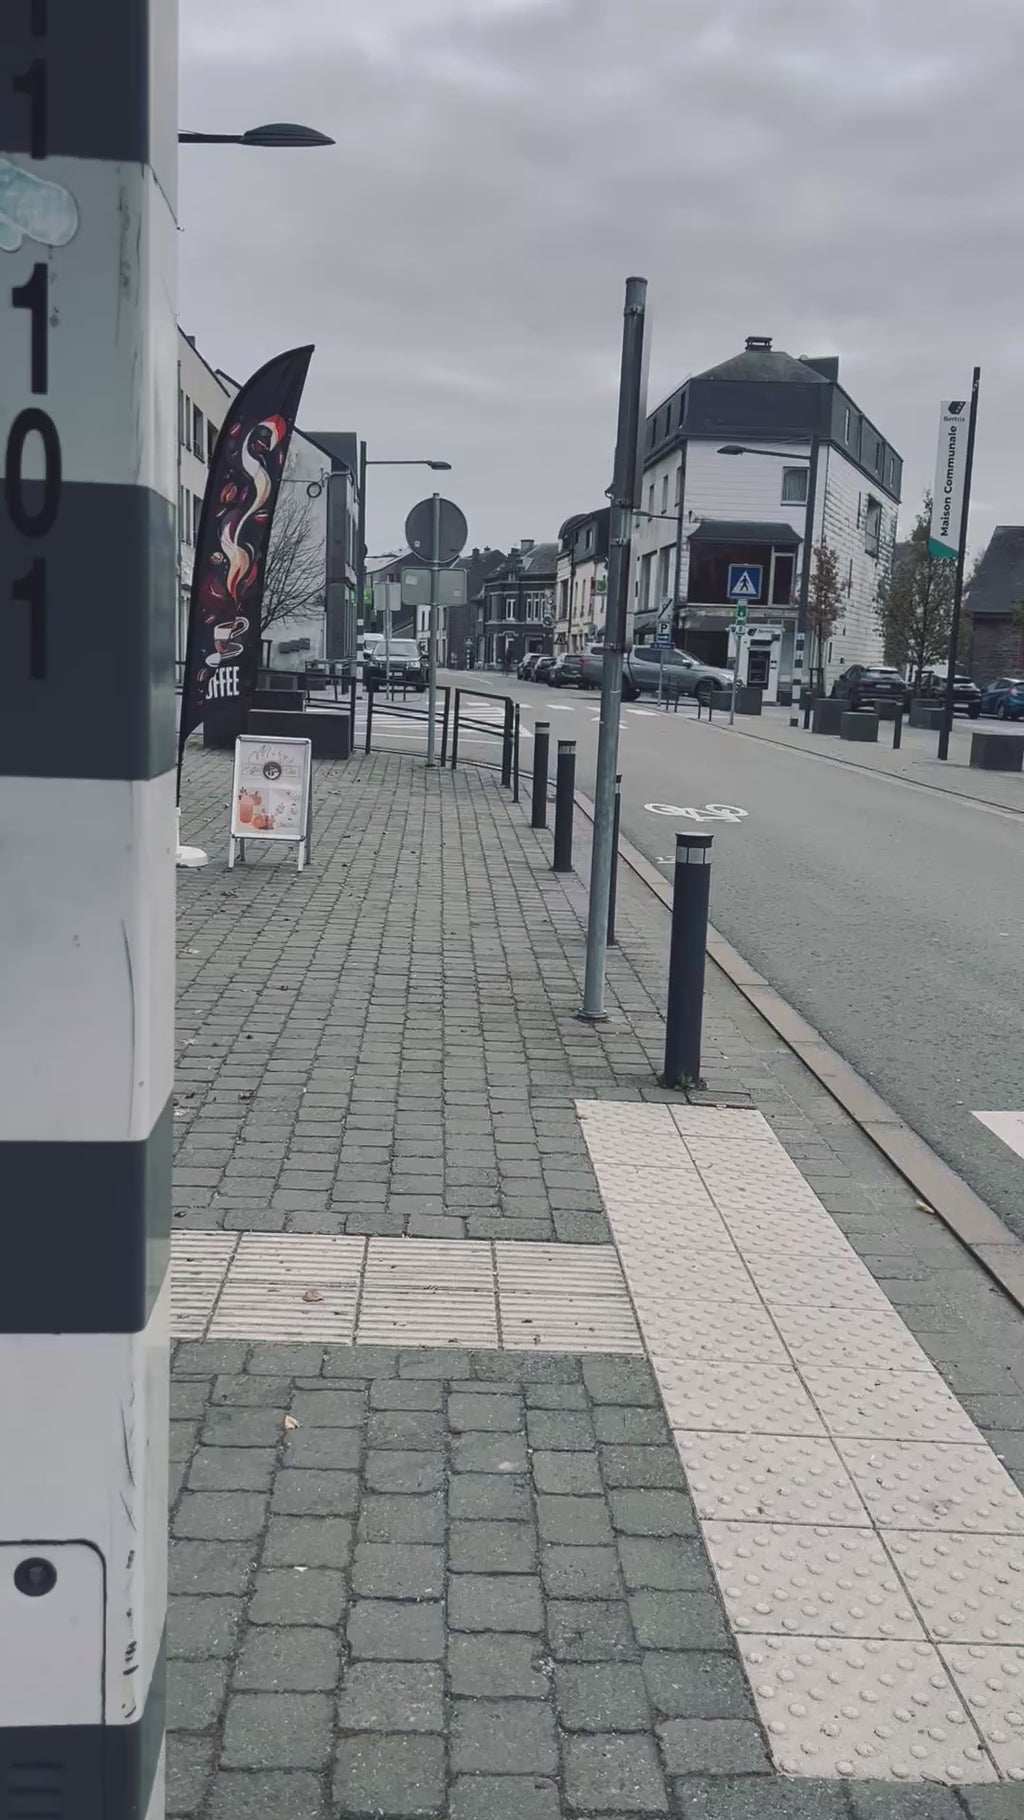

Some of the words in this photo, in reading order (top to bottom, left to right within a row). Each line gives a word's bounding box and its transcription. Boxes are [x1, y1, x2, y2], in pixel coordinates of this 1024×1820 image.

[944, 425, 958, 494] Communale
[940, 497, 952, 537] Maison
[660, 623, 668, 634] P
